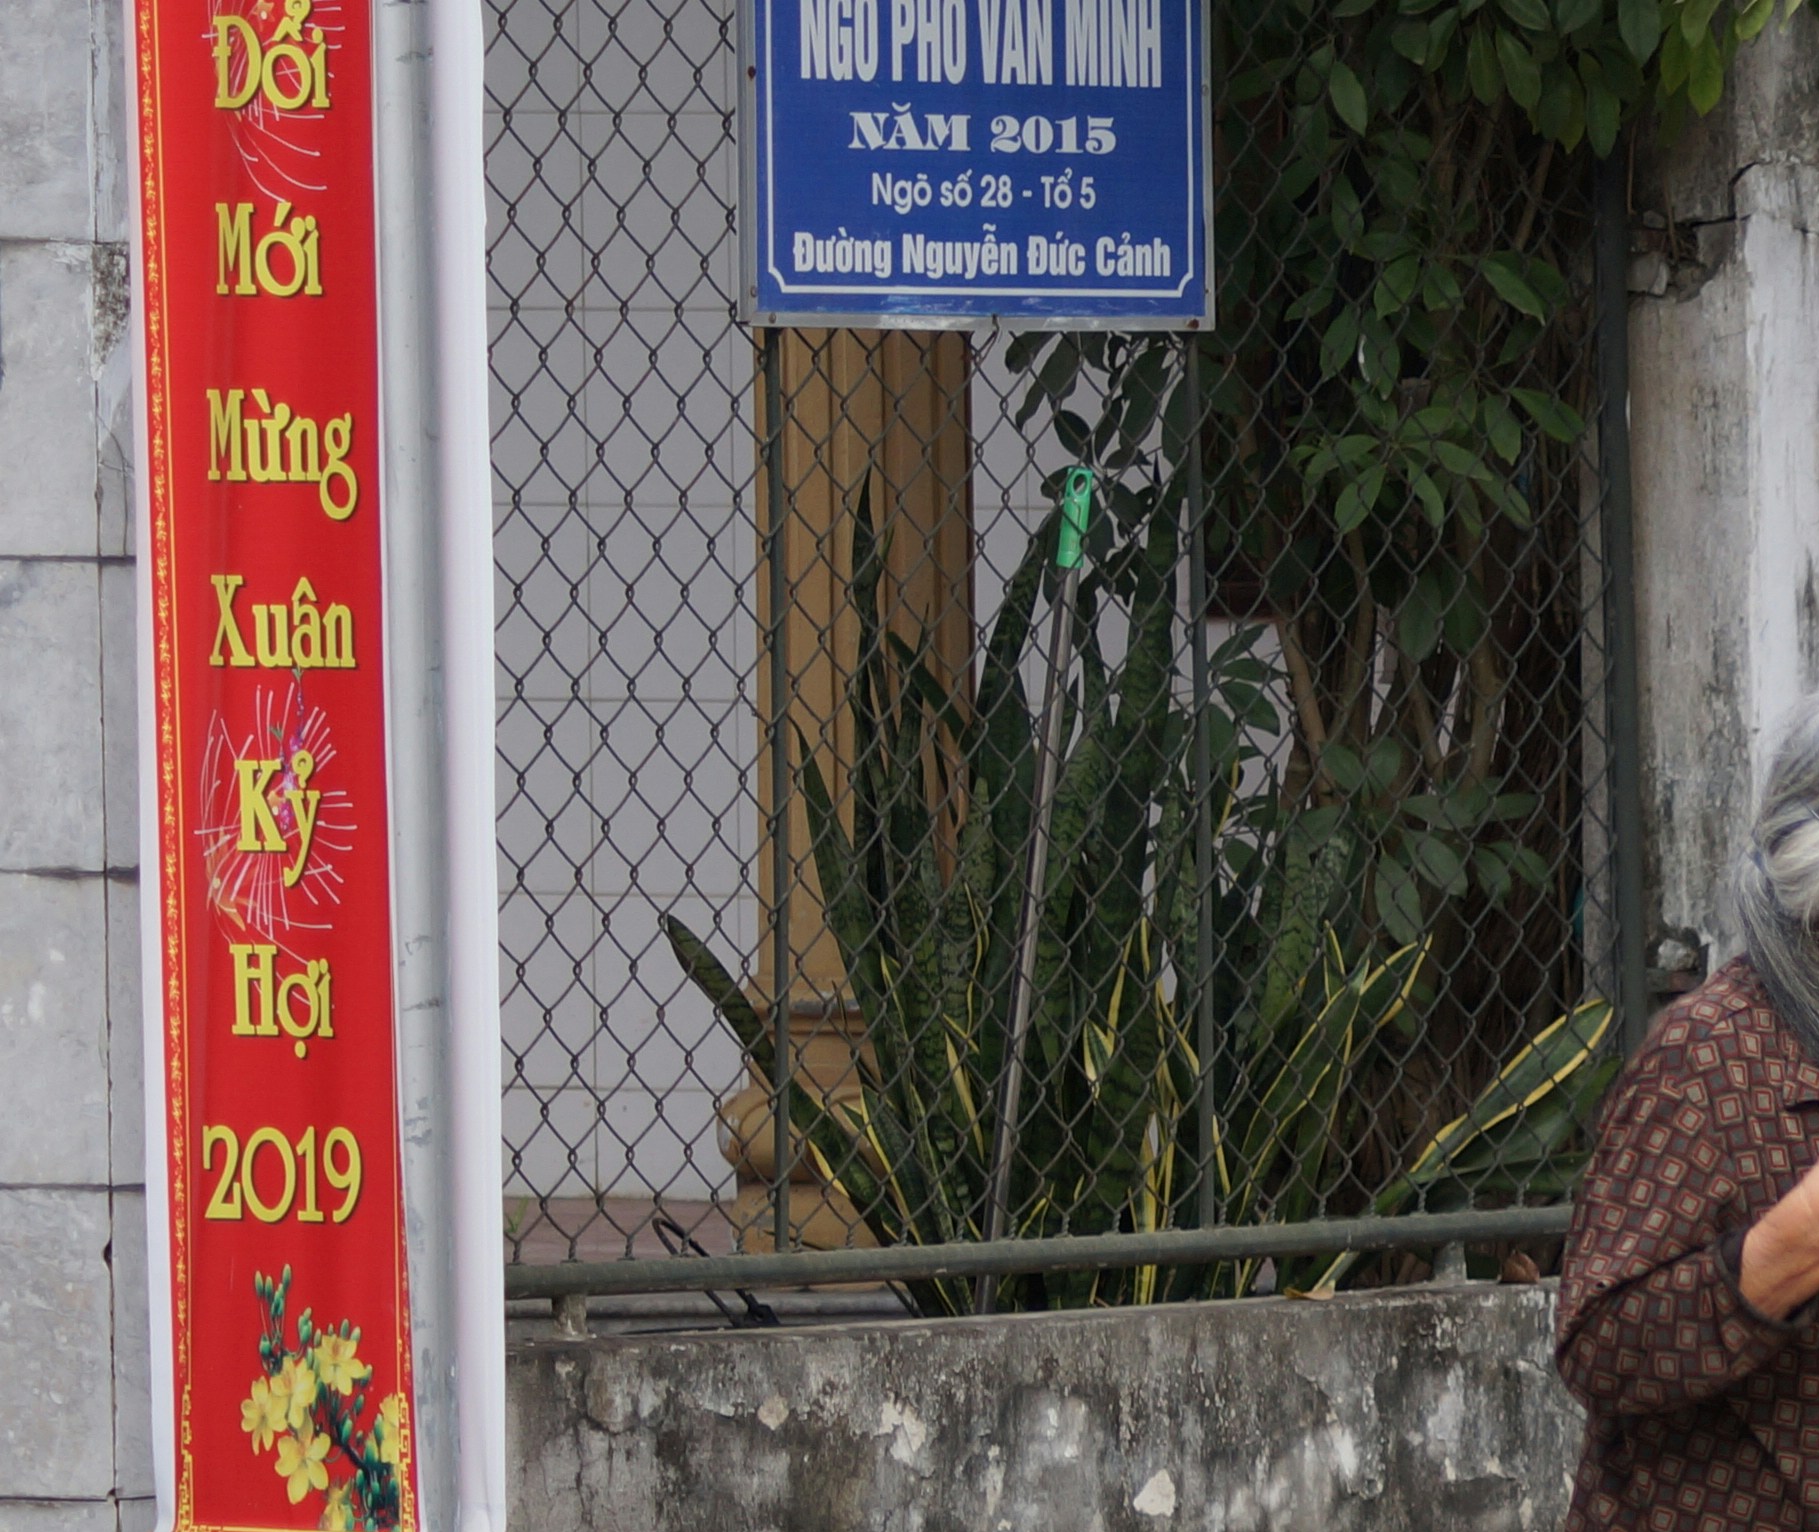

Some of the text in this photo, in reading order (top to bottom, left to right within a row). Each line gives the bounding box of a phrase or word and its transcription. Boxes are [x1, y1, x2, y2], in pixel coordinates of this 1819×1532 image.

[211, 0, 330, 109] Đổi
[1066, 0, 1163, 88] MINH
[848, 101, 1117, 155] NĂM 2015
[871, 172, 932, 214] Ngõ
[940, 168, 973, 207] số
[980, 174, 1014, 208] 28
[1041, 167, 1073, 209] Tổ
[1079, 177, 1097, 209] 5
[214, 201, 323, 297] Mới
[792, 222, 1172, 280] Đường Nguyễn Đức Cảnh
[206, 388, 358, 521] Mừng
[209, 573, 356, 669] Xuân
[233, 749, 321, 888] Kỷ
[229, 943, 334, 1059] Hợi
[202, 1124, 363, 1224] 2019
